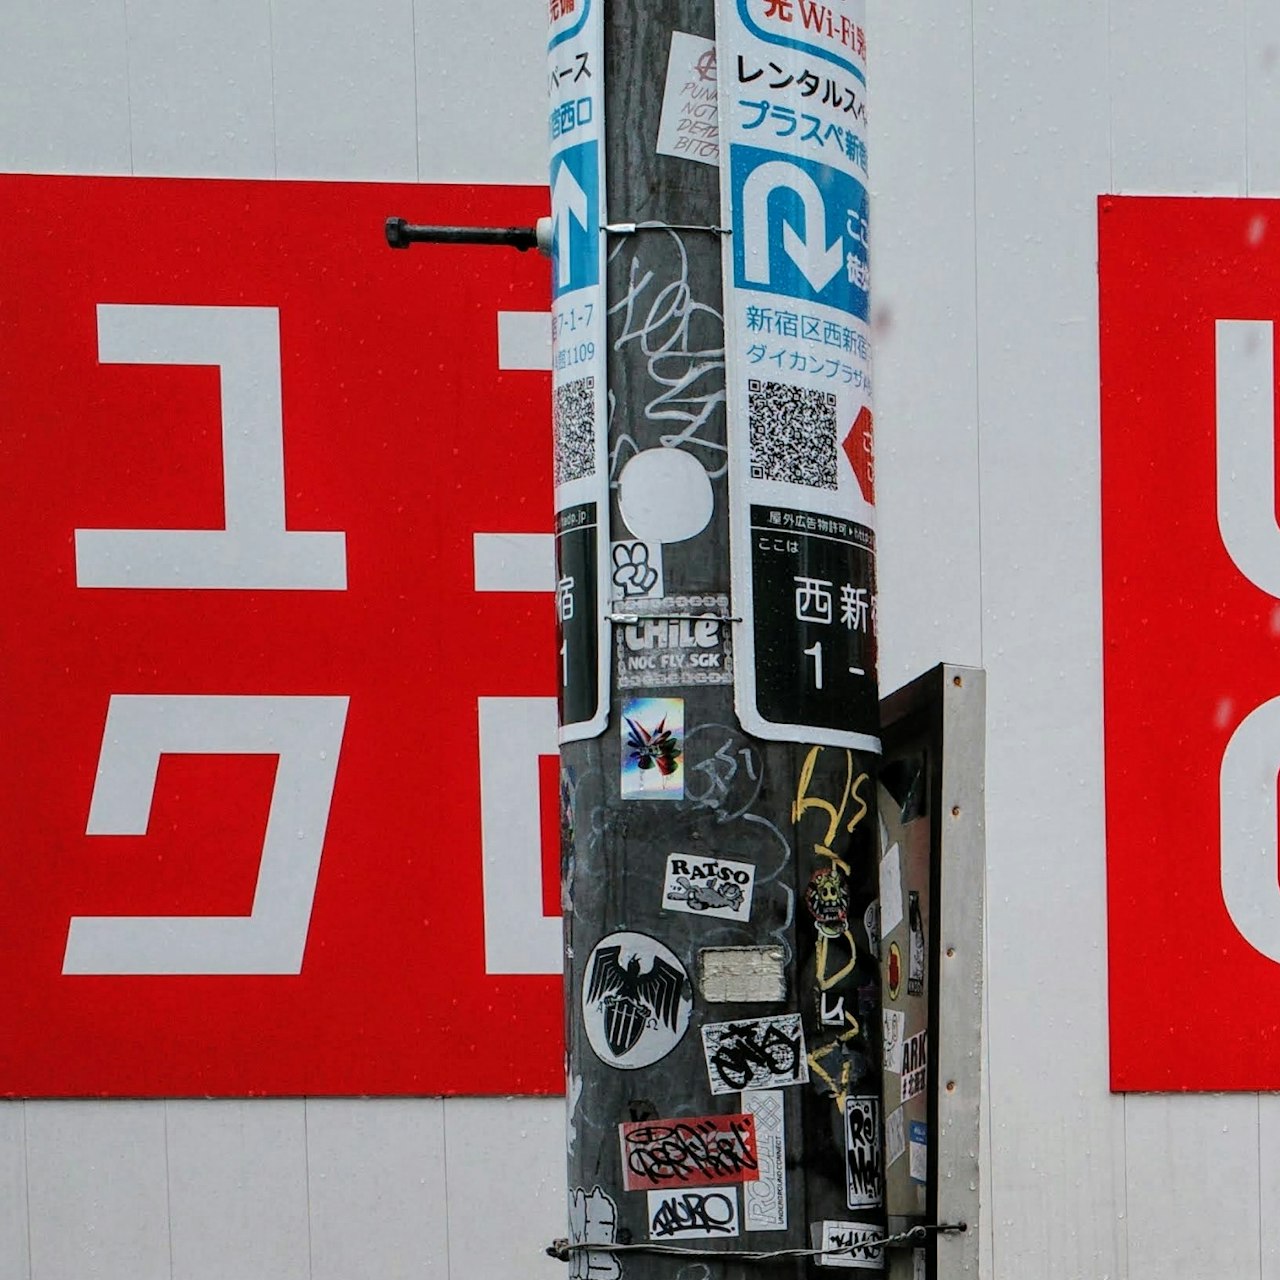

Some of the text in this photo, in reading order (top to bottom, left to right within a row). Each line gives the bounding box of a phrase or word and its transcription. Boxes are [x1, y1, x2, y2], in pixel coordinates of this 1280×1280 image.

[758, 538, 800, 553] ここは
[793, 575, 876, 636] 西新
[690, 652, 720, 668] SGK
[671, 859, 750, 885] RATSO
